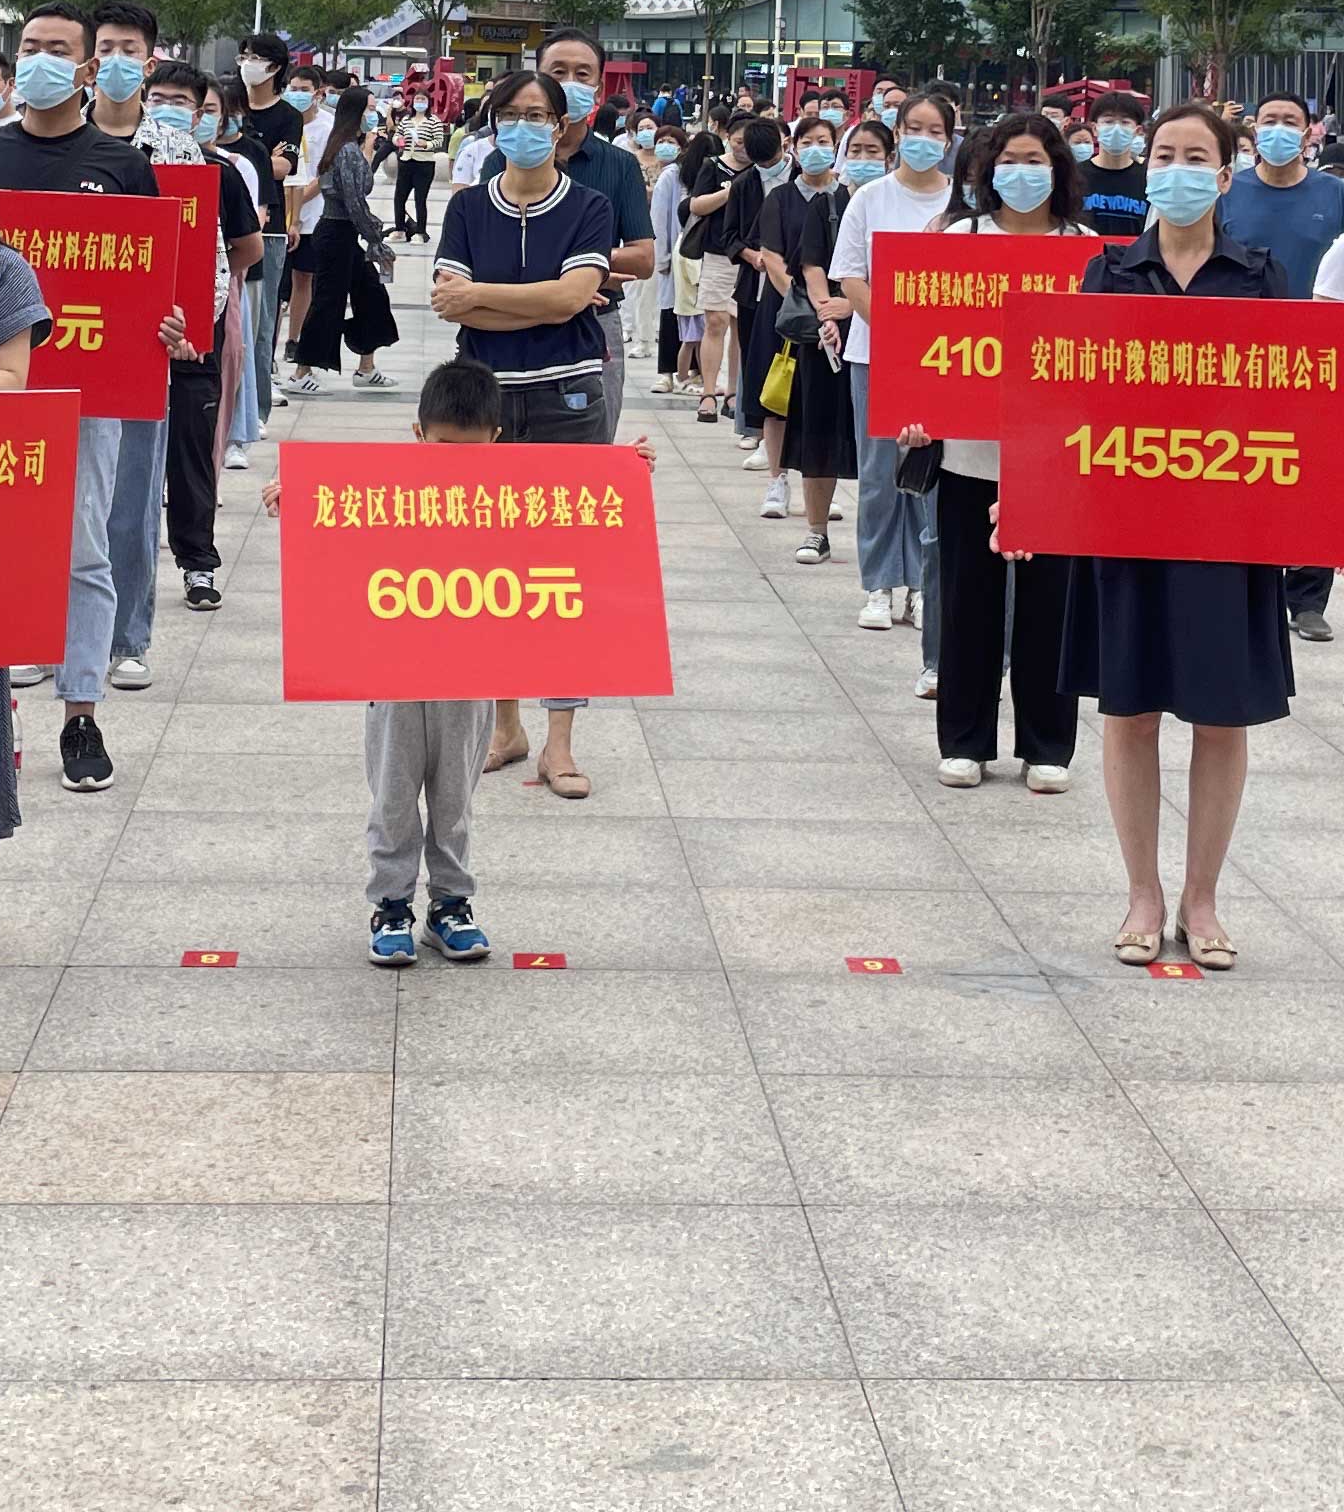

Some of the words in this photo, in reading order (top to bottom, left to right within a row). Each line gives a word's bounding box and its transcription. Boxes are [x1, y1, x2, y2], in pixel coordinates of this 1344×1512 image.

[1030, 336, 1337, 391] 安阳市中豫锦明硅业有限公司
[1064, 425, 1300, 485] 14552元
[312, 484, 624, 529] 龙安区妇联联合体彩基金会
[367, 568, 584, 620] 6000元
